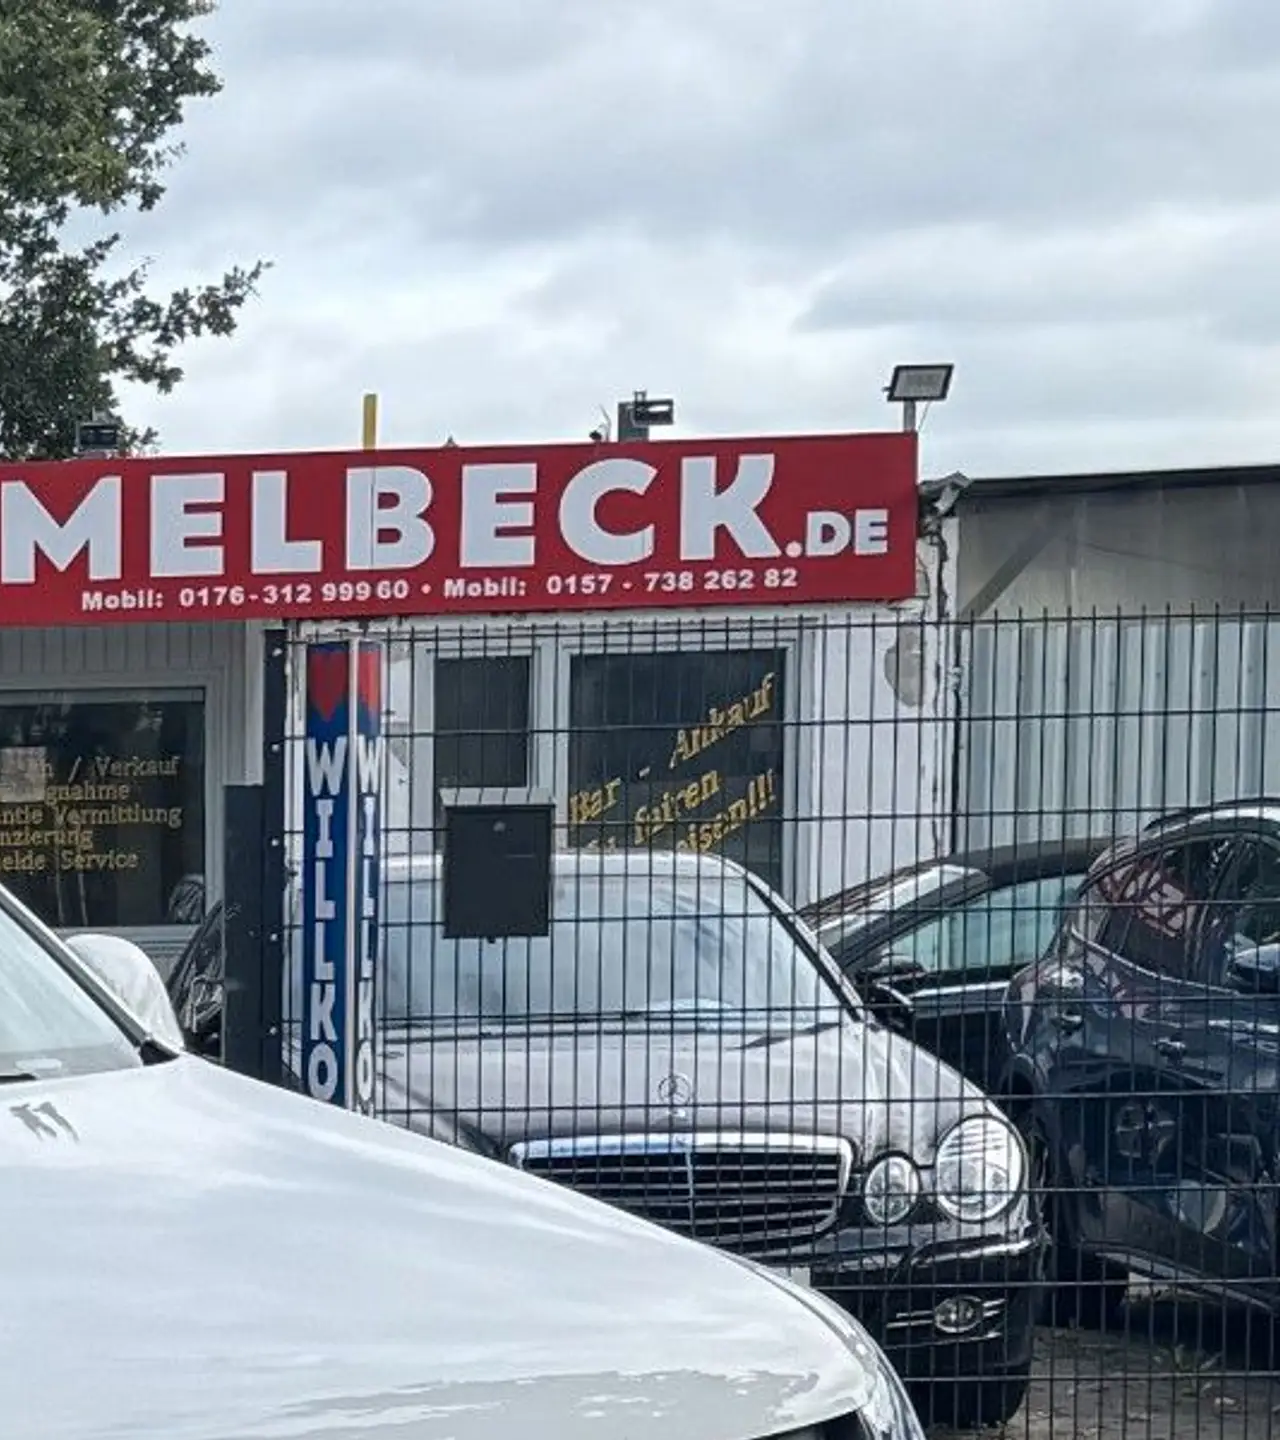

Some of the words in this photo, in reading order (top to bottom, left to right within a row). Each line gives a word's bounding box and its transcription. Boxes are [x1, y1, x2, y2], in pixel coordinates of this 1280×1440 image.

[0, 454, 889, 585] MELBECK.DE
[81, 589, 164, 611] Mobil:
[443, 576, 527, 599] Mobil:
[546, 573, 613, 595] 0157
[645, 571, 693, 592] 738
[704, 569, 753, 590] 262
[764, 568, 798, 588] 82
[61, 849, 140, 870] Service
